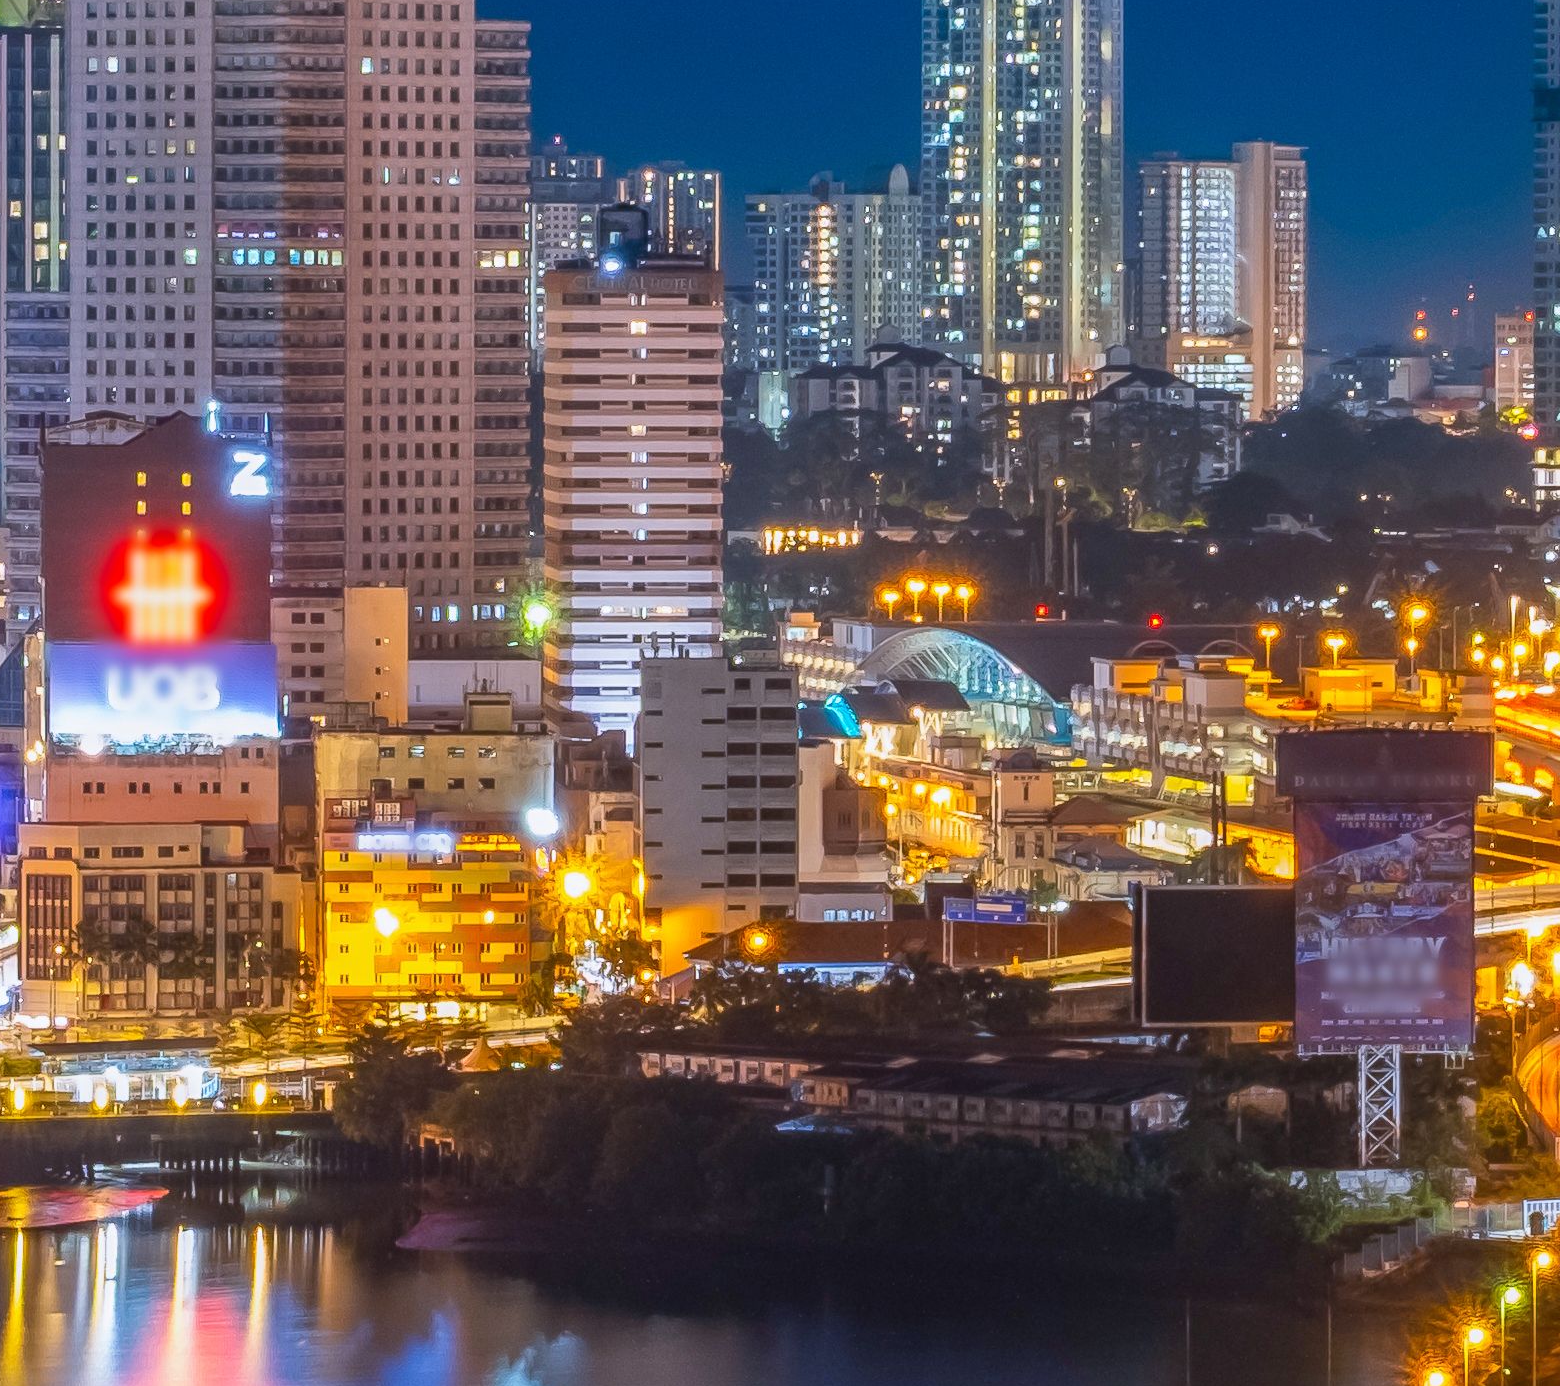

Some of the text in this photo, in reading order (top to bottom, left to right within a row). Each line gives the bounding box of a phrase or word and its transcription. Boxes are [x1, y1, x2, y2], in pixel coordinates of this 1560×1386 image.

[572, 275, 697, 291] CENTRAL HOTEL
[107, 664, 221, 711] UOB
[1294, 774, 1477, 788] DAULAT TUANKU
